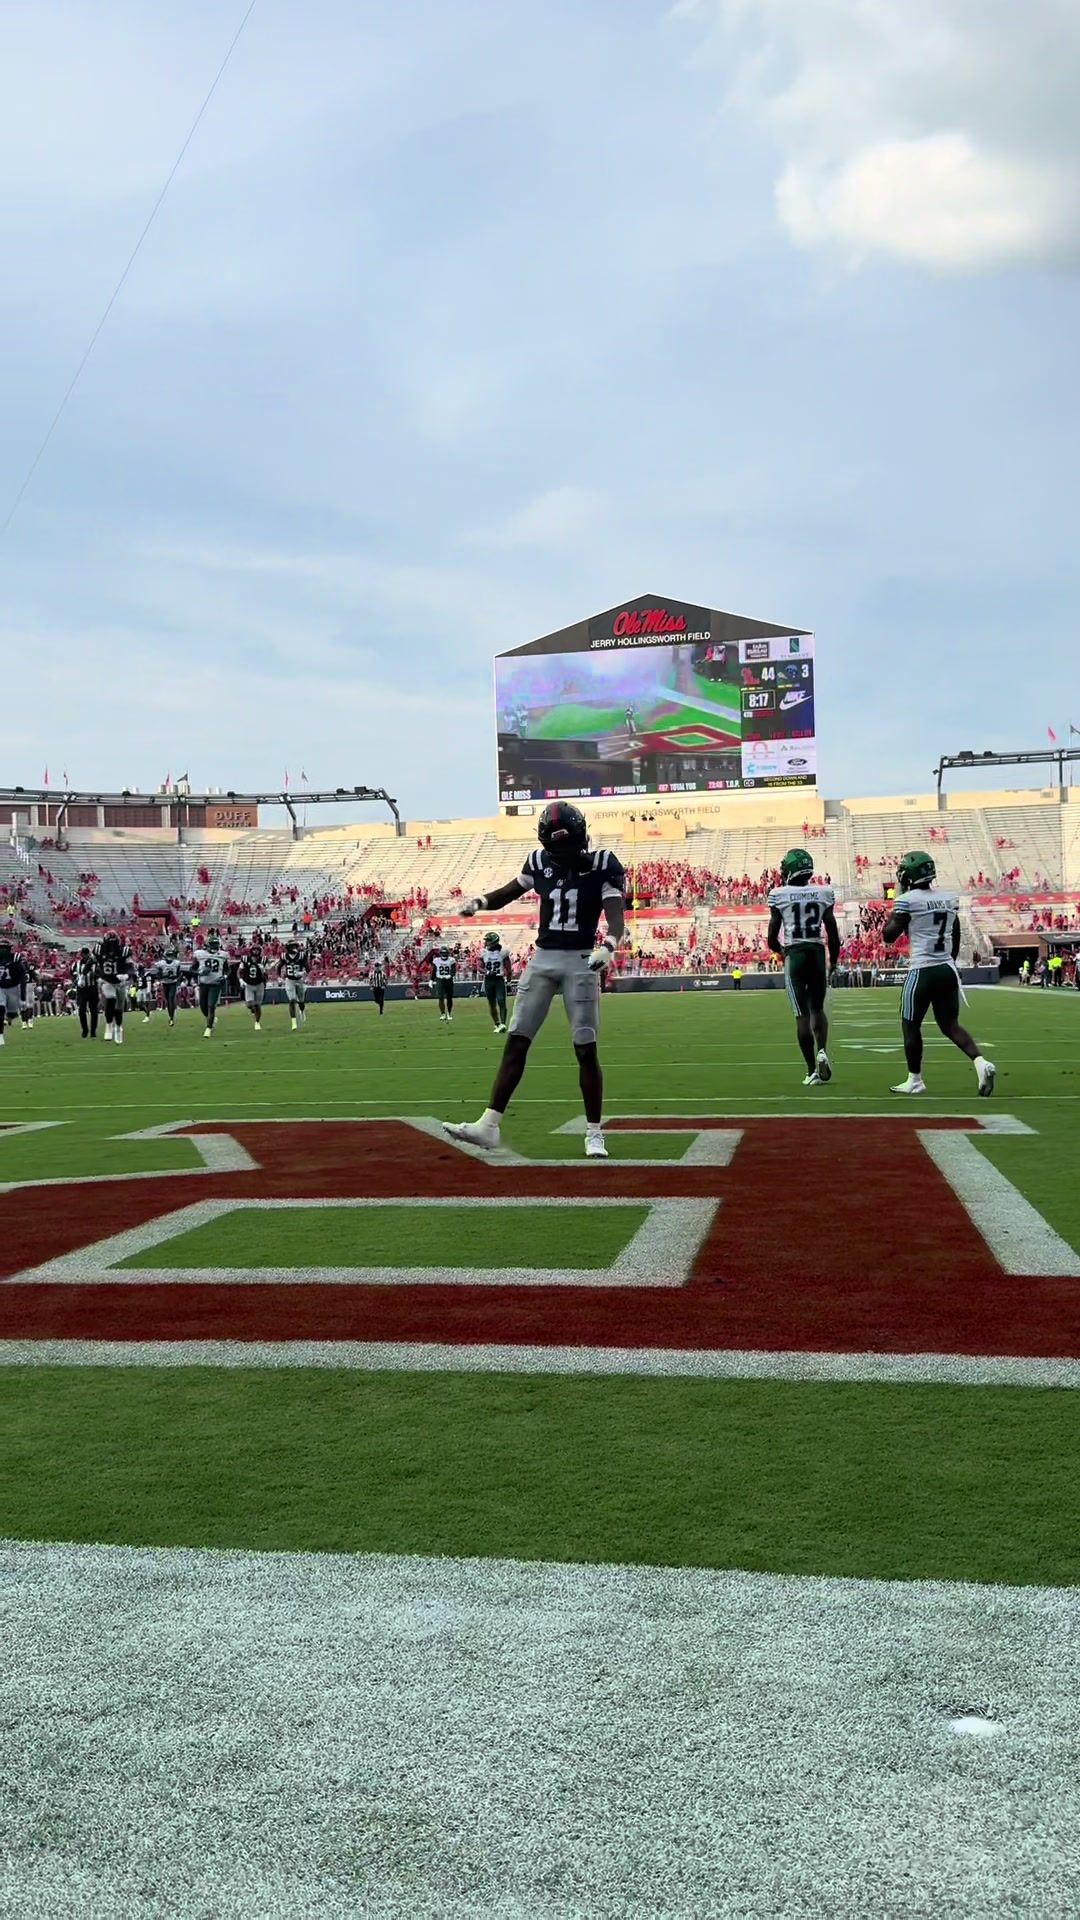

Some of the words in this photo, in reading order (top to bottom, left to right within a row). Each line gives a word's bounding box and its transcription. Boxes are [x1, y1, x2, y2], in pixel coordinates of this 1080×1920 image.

[613, 610, 641, 636] Ole
[641, 608, 687, 633] Miss
[590, 639, 618, 648] JERRY
[618, 634, 686, 646] HOLLINGSWORTH
[687, 632, 711, 640] FIELD
[761, 666, 775, 680] 44
[801, 664, 809, 678] 3
[748, 693, 769, 707] 8:17
[501, 791, 513, 800] OLE
[513, 790, 531, 800] MISS
[216, 811, 251, 820] DUFF
[594, 811, 619, 820] JERRY
[697, 806, 721, 814] FIELD
[548, 888, 579, 931] 11
[791, 902, 821, 939] 12
[933, 912, 947, 953] 7
[103, 962, 118, 975] 61
[204, 959, 219, 973] 92
[249, 967, 257, 979] 9
[438, 966, 451, 976] 29
[485, 961, 500, 973] 42
[325, 989, 357, 999] BankPlus
